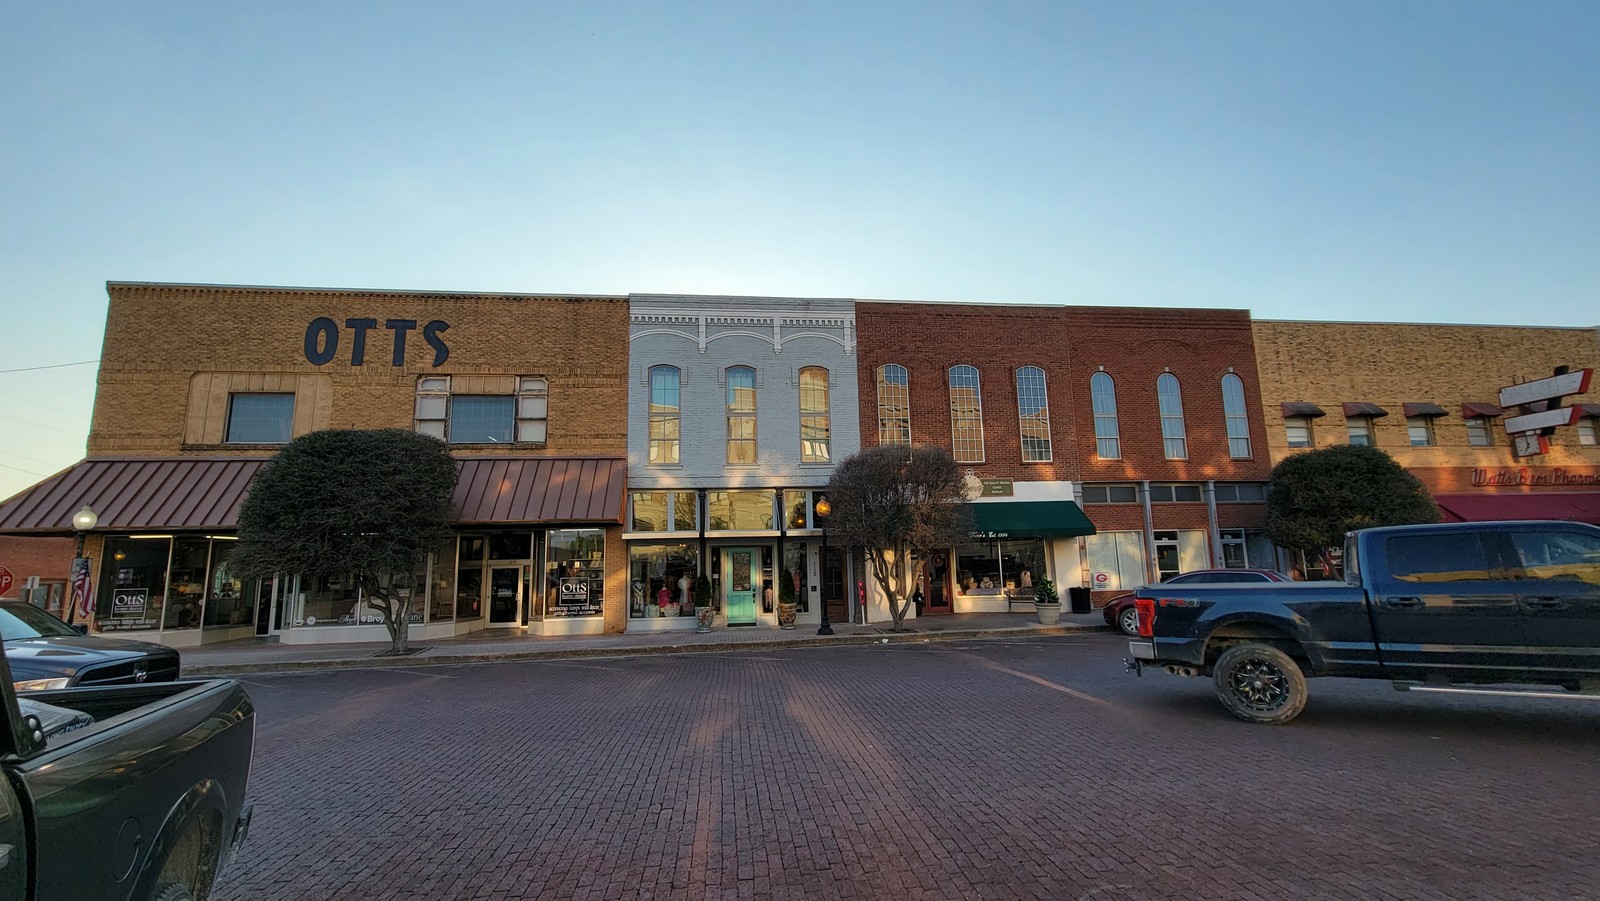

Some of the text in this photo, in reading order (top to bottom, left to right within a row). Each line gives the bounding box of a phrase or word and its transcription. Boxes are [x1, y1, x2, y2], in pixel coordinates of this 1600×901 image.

[304, 317, 450, 367] OTTS
[1471, 468, 1512, 486] Watts
[1517, 467, 1548, 486] Bros
[562, 583, 587, 592] OttS
[115, 594, 145, 606] OttS
